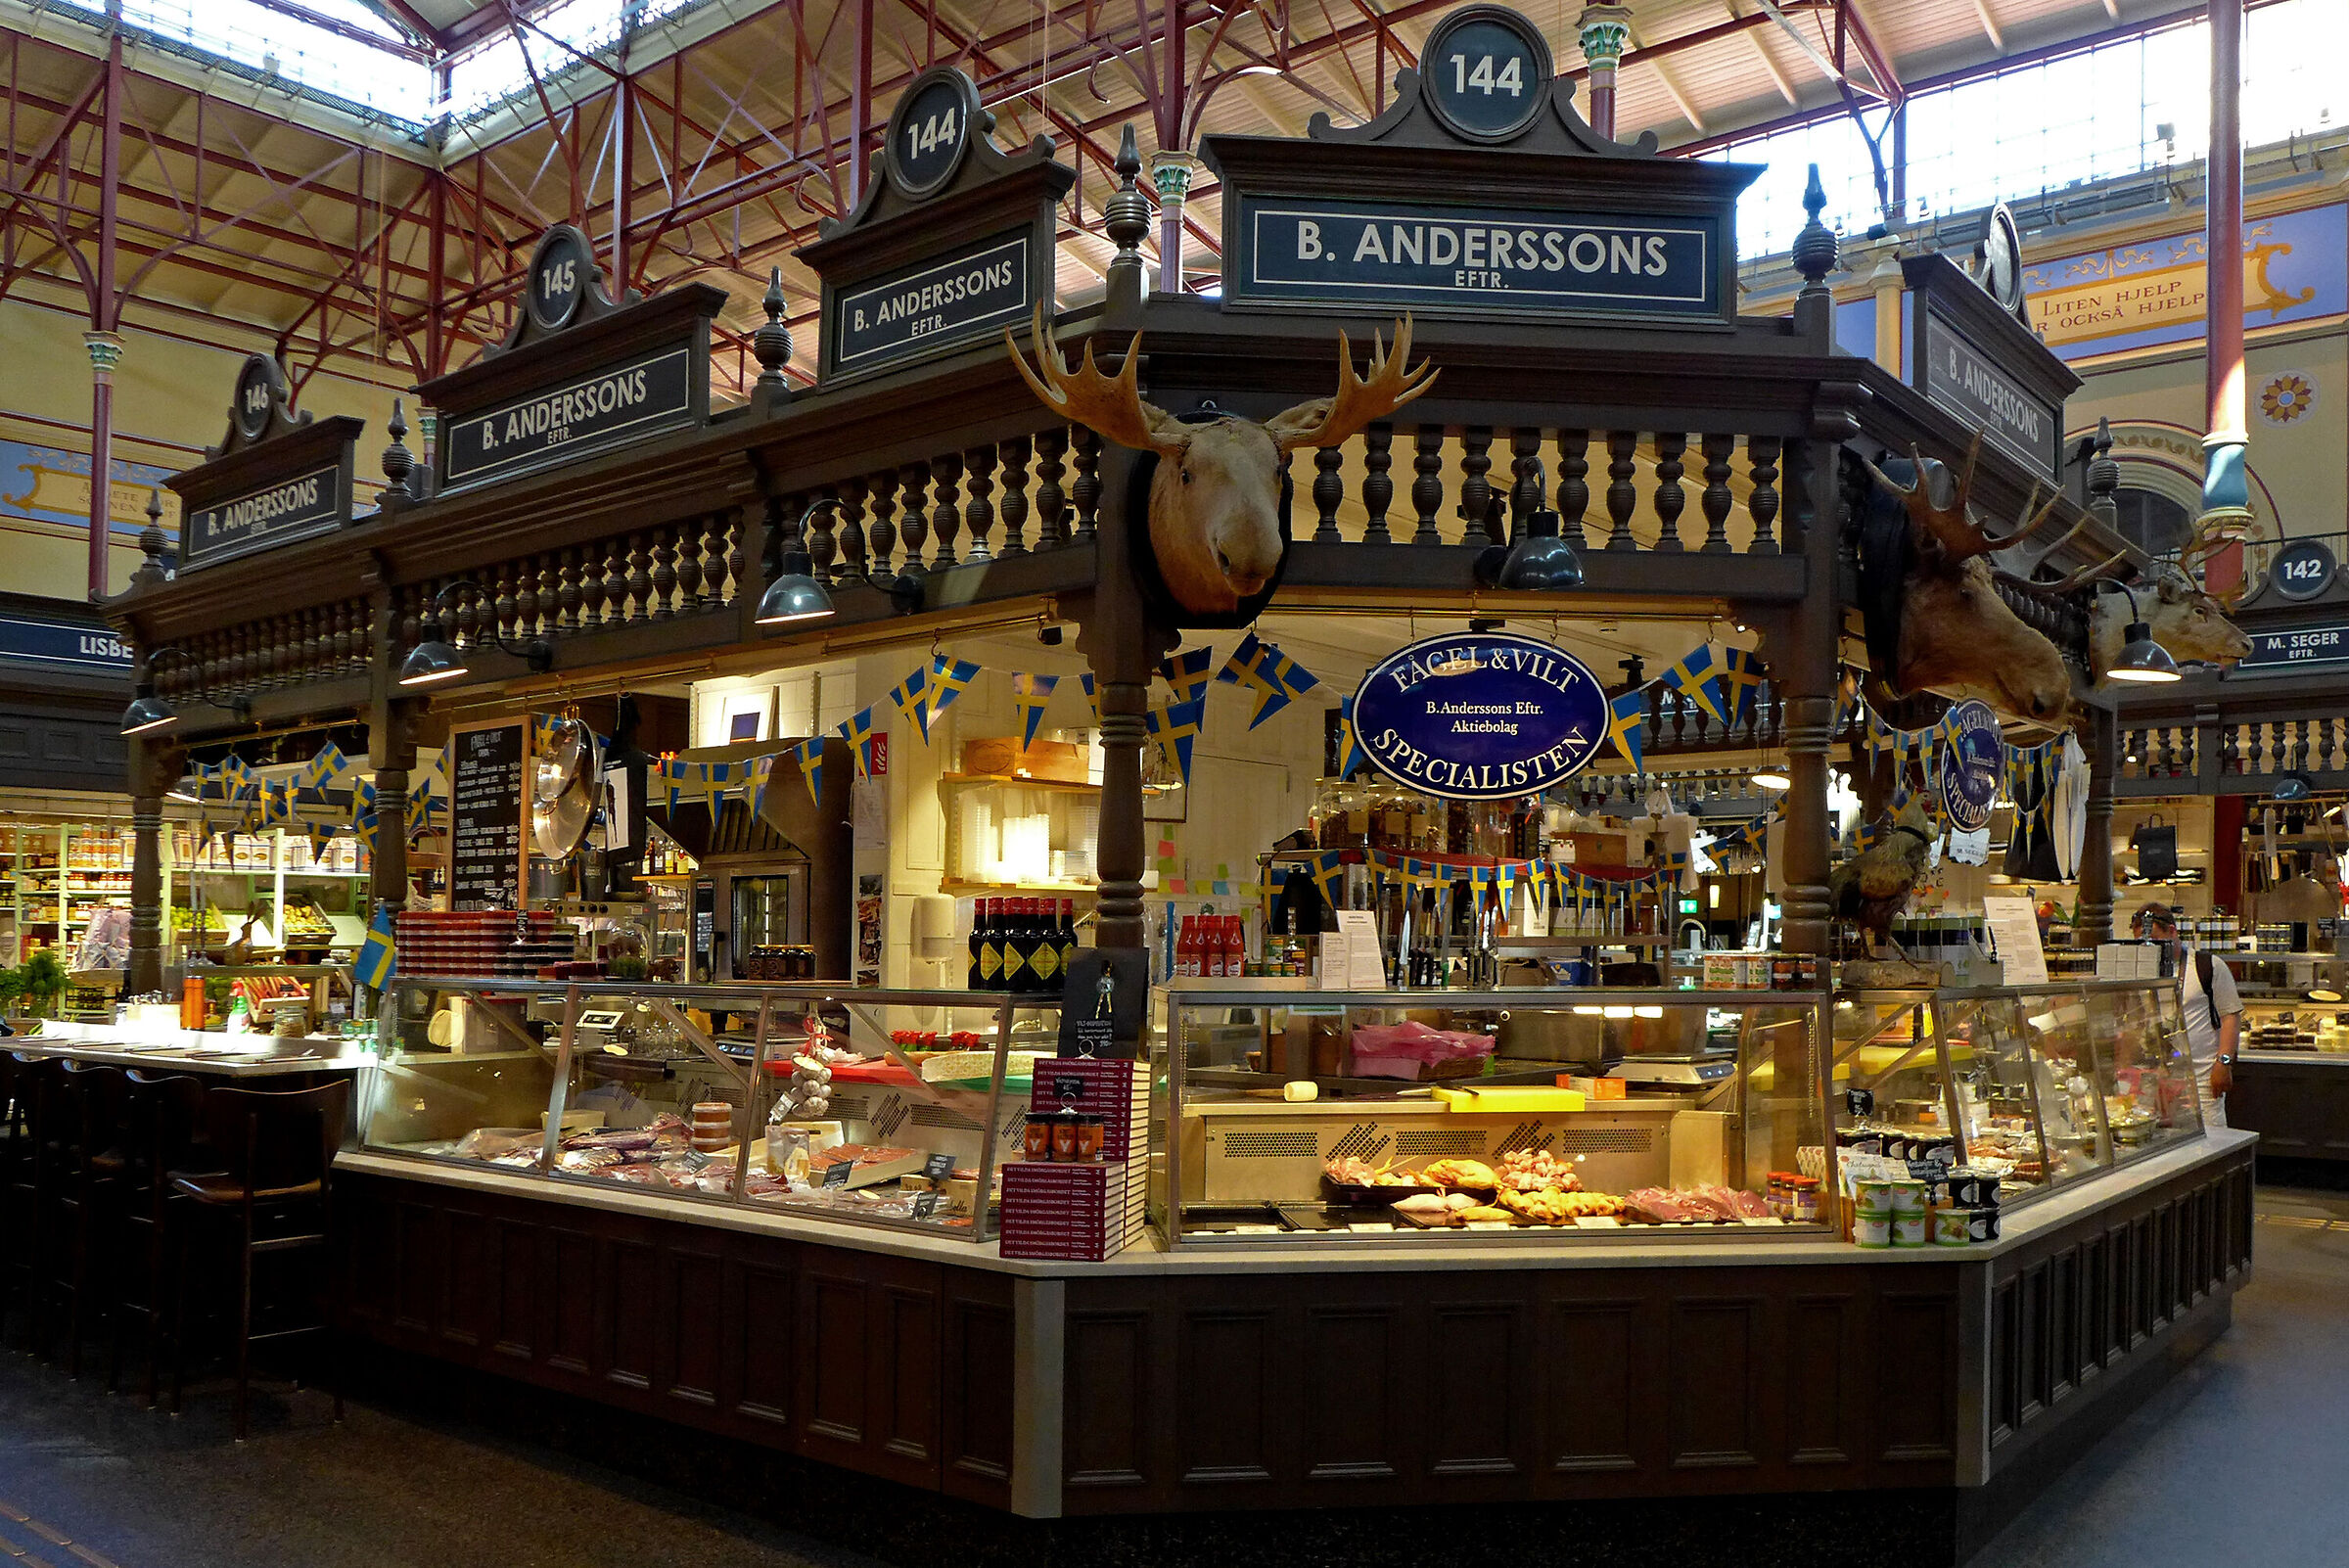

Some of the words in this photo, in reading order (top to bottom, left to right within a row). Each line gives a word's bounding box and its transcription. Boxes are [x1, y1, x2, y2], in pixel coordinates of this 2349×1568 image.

[1449, 54, 1524, 98] 144
[907, 107, 956, 160] 144
[1297, 220, 1336, 263] B.
[1353, 223, 1669, 277] ANDERSSONS
[542, 259, 576, 300] 145
[854, 308, 871, 333] B.
[877, 259, 1013, 327] ANDERSSONS
[1454, 269, 1510, 290] EFTR.
[2044, 296, 2102, 317] LITEN
[2116, 281, 2183, 303] HJELP
[2139, 293, 2205, 315] HJELP
[911, 314, 948, 337] EFTR.
[246, 383, 269, 415] 146
[482, 420, 500, 451] B.
[505, 369, 647, 444] ANDERSSONS
[1949, 346, 1961, 385] B.
[1964, 359, 2040, 443] ANDERSSONS
[546, 427, 574, 446] EFTR.
[207, 512, 221, 536] B.
[224, 477, 319, 532] ANDERSSONS
[2283, 559, 2323, 580] 142
[2267, 636, 2286, 650] M.
[2291, 632, 2340, 648] SEGER
[2288, 648, 2318, 660] EFTR.
[1515, 701, 1544, 715] Eftr.
[1451, 720, 1519, 736] Aktiebolag
[1373, 726, 1589, 791] SPECIALISTEN
